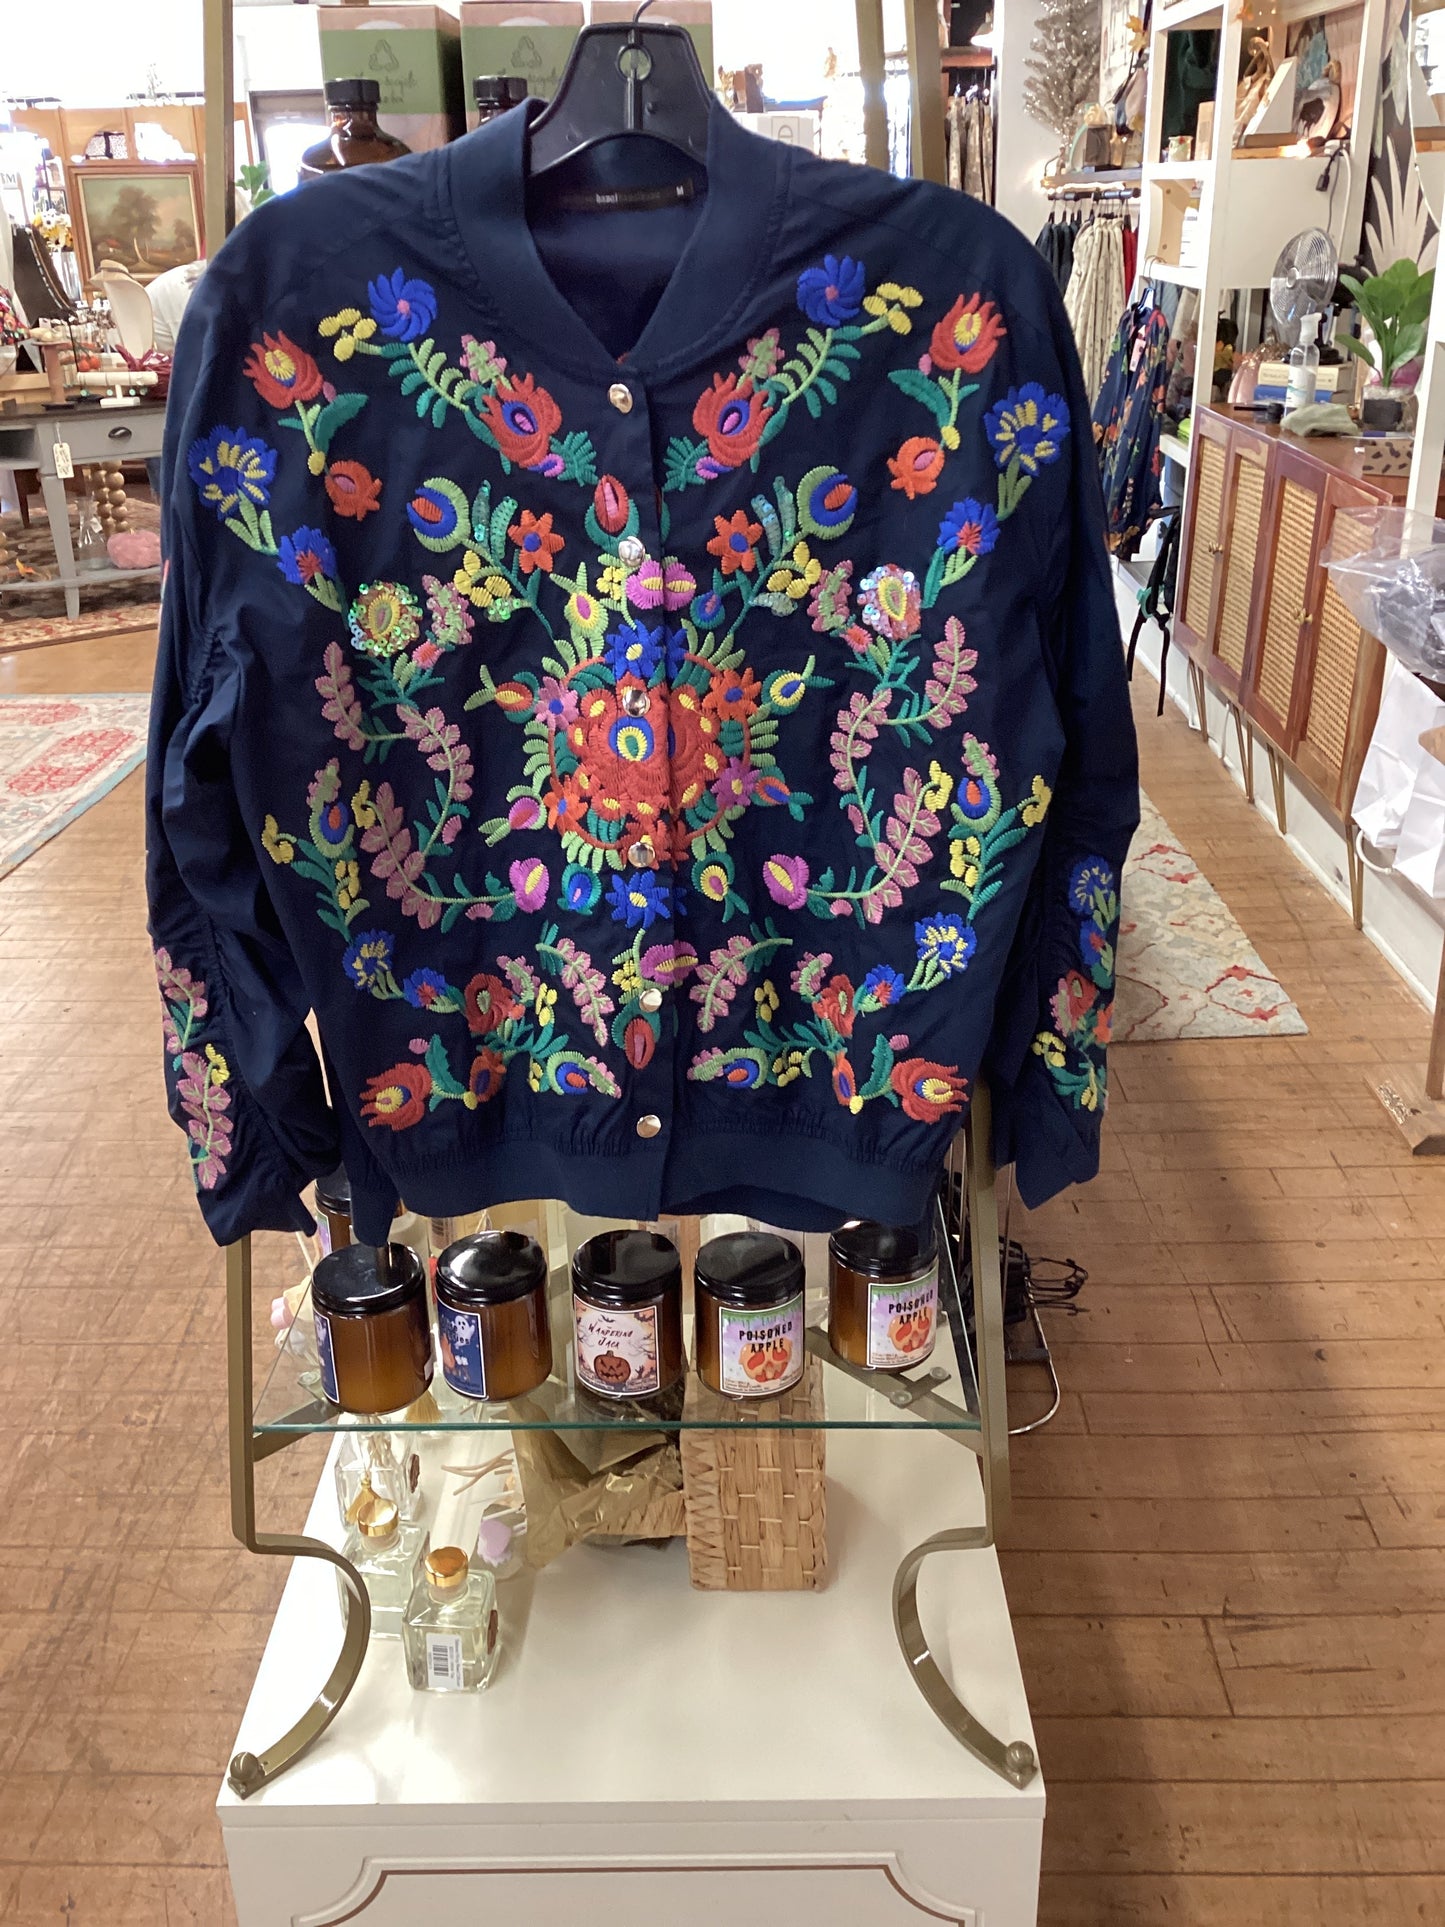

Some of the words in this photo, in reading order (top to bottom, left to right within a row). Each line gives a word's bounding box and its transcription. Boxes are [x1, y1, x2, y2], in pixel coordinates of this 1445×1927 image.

[888, 1289, 934, 1313] POISONED
[899, 1306, 927, 1325] APPLE
[739, 1321, 793, 1341] POISONED
[750, 1338, 784, 1353] APPLE
